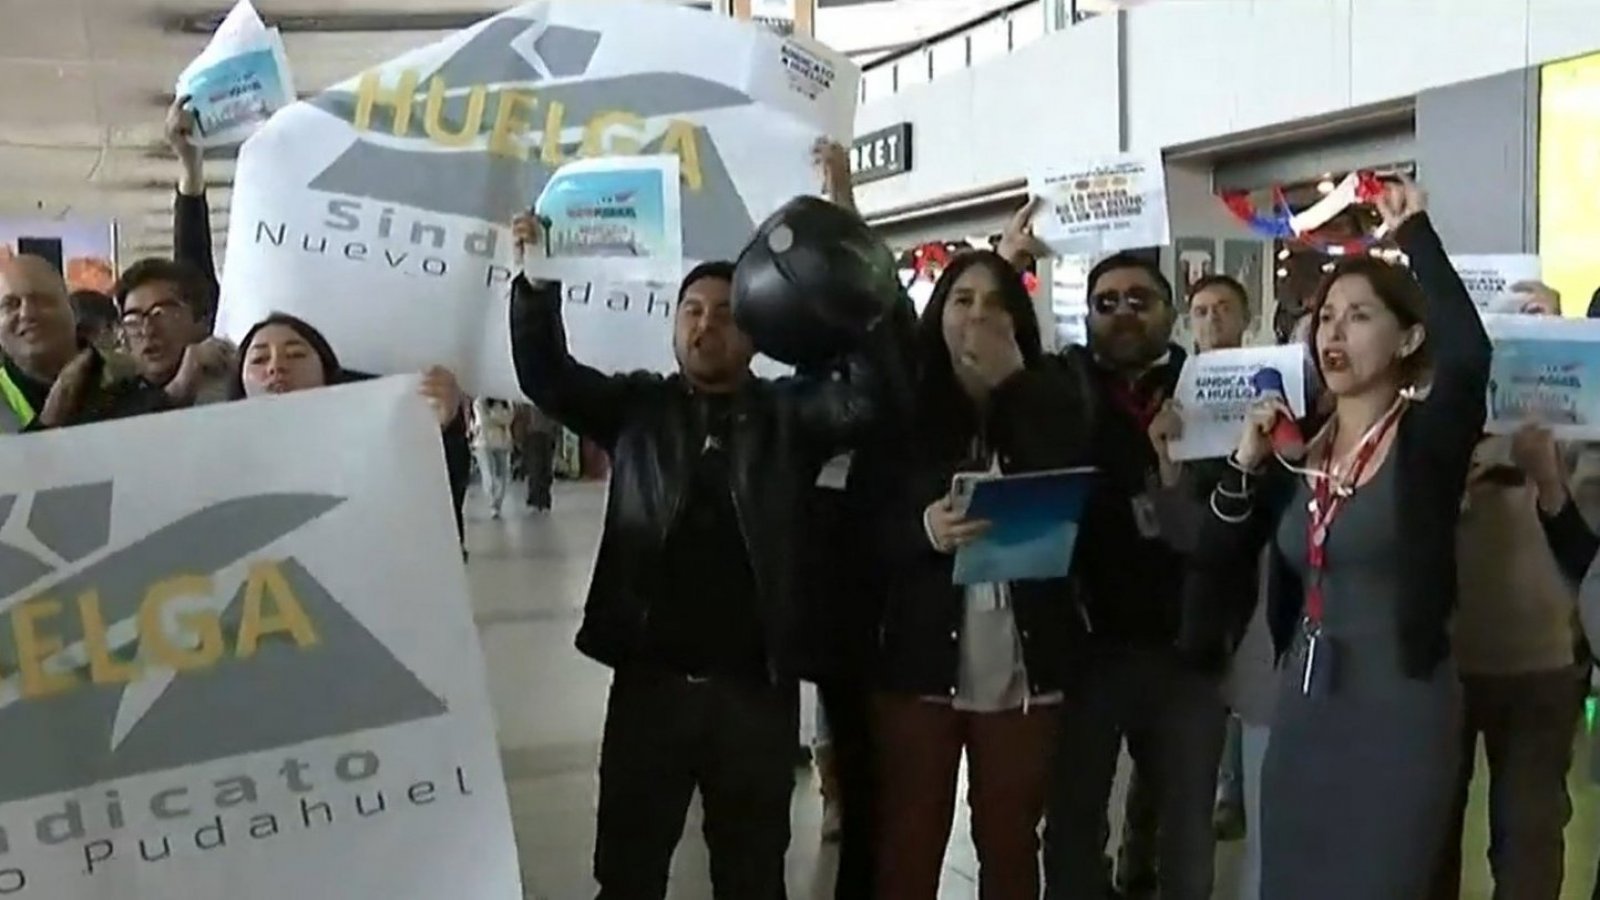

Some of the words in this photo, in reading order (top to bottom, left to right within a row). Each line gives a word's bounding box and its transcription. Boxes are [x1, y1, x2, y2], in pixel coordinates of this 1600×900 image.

[354, 69, 703, 190] HUELGA
[256, 220, 447, 278] Nuevo
[1196, 375, 1246, 387] SINDICA
[9, 559, 320, 697] ELGA
[84, 767, 471, 876] Pudahuel
